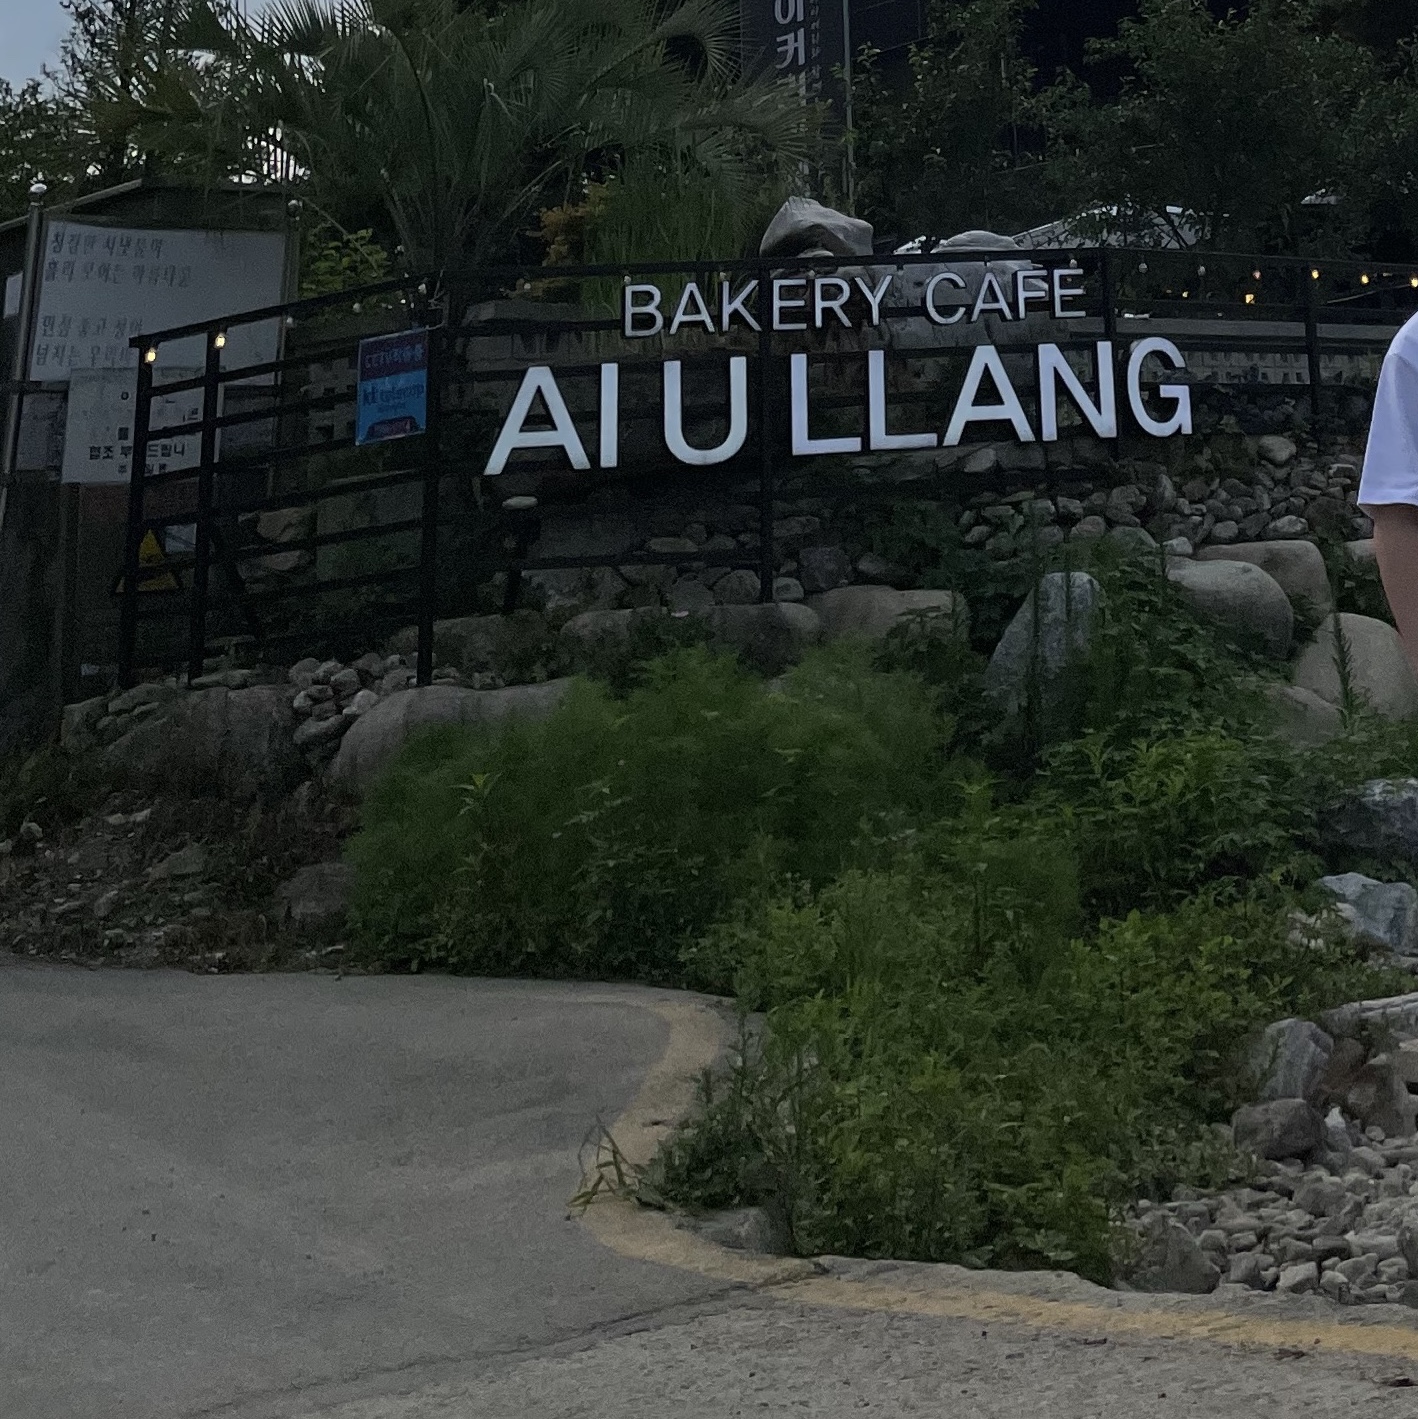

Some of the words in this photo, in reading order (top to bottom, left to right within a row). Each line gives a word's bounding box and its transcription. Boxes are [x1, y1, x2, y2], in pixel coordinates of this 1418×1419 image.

[623, 274, 894, 337] BAKERY
[926, 268, 1087, 325] CAFE
[482, 336, 1194, 476] AIULLANG
